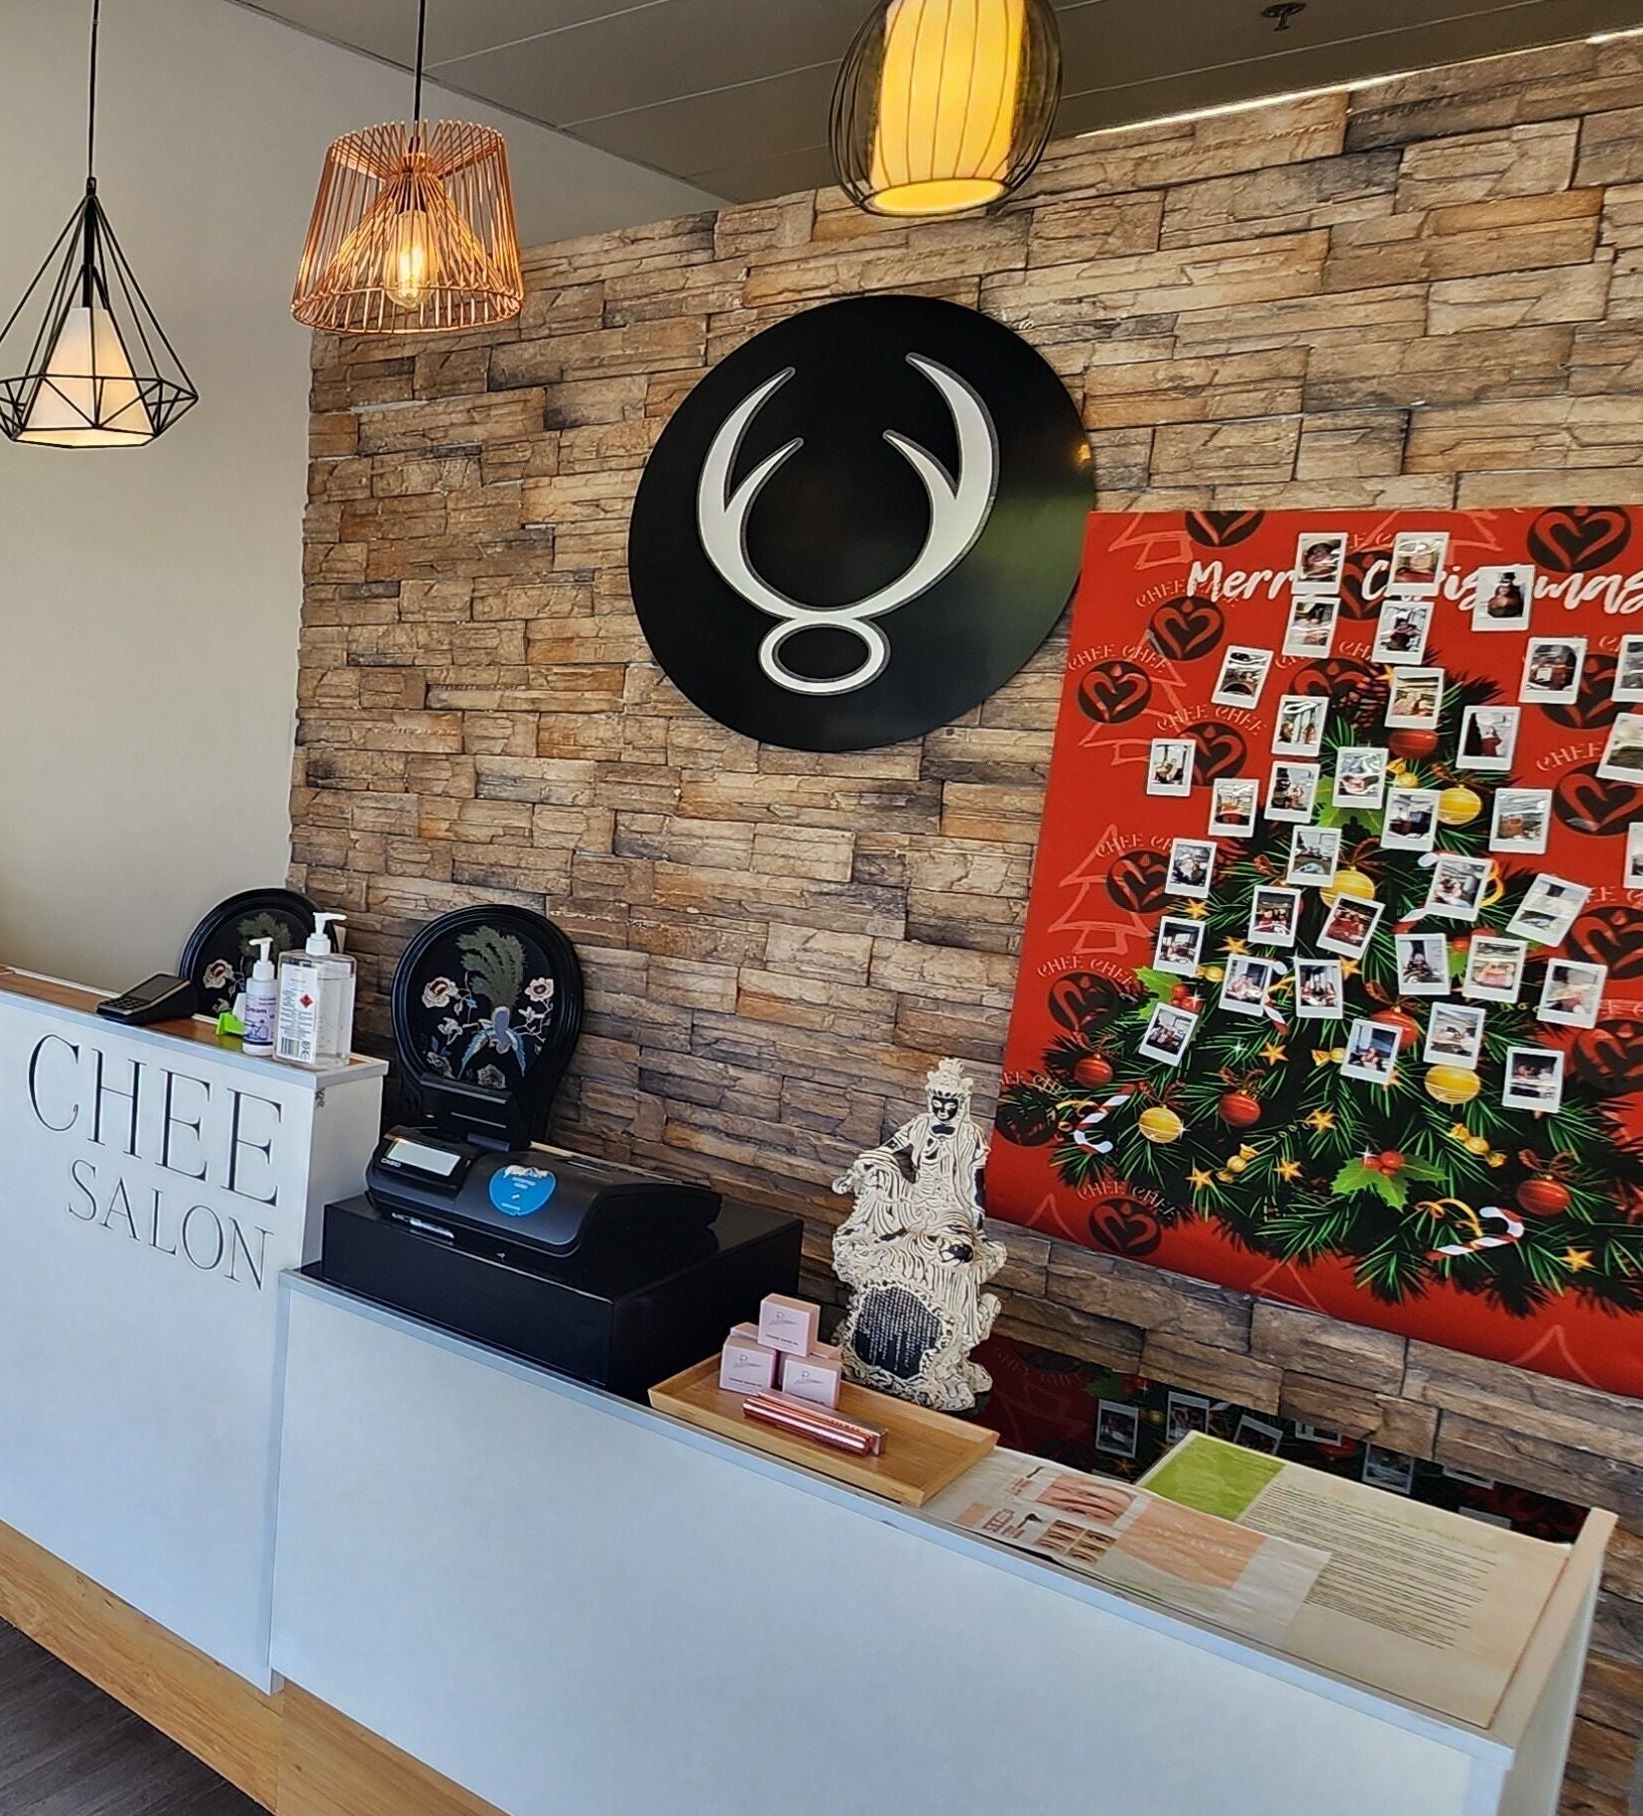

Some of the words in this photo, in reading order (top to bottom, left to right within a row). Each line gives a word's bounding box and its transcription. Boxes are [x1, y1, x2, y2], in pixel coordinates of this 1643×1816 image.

[1186, 560, 1300, 603] Merr
[1068, 643, 1116, 671] CHEE
[1157, 704, 1208, 732] CHEE
[1037, 956, 1084, 977] CHEE
[27, 1033, 282, 1207] CHEE
[67, 1159, 273, 1291] SALON
